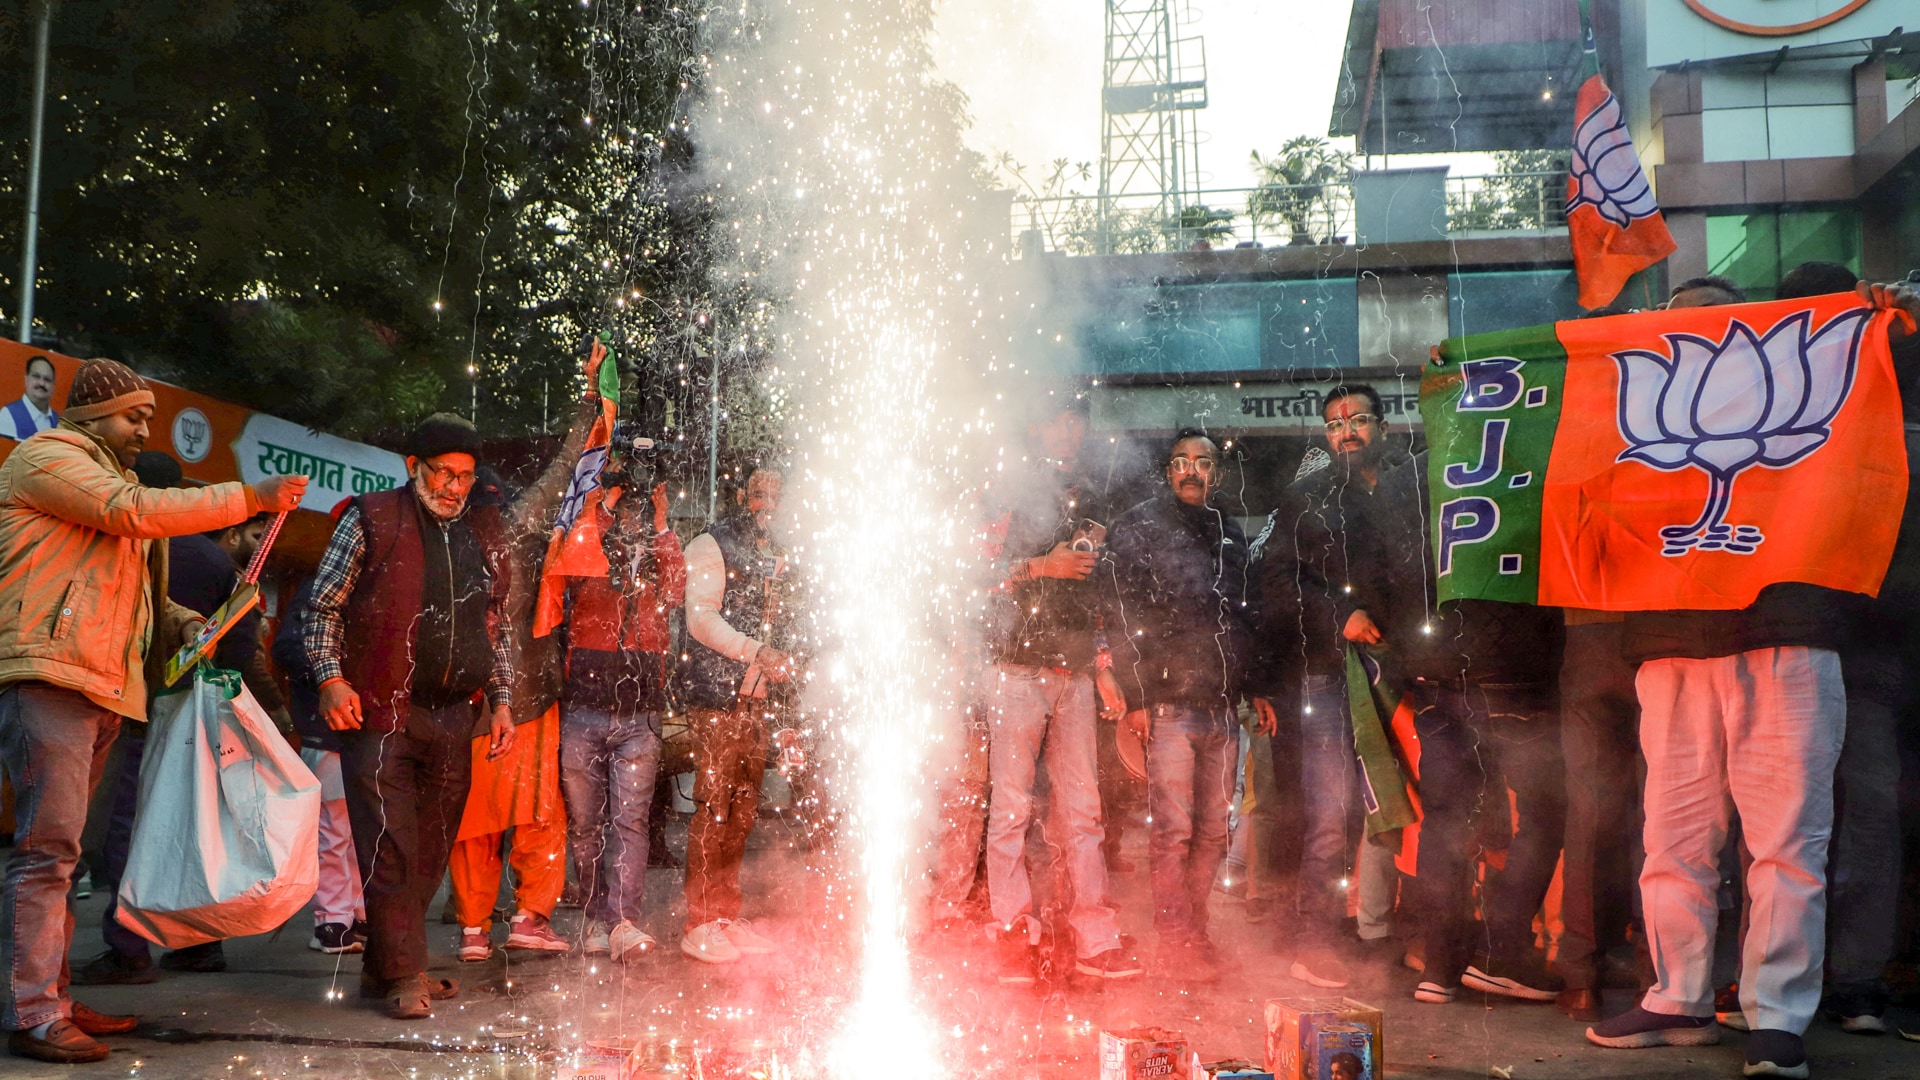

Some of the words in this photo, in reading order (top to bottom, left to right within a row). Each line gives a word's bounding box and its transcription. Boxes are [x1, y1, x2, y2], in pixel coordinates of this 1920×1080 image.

[1241, 389, 1326, 417] भारती
[258, 440, 347, 493] स्वागत
[1141, 1063, 1174, 1077] AERIAL
[1145, 1056, 1168, 1068] NUTS
